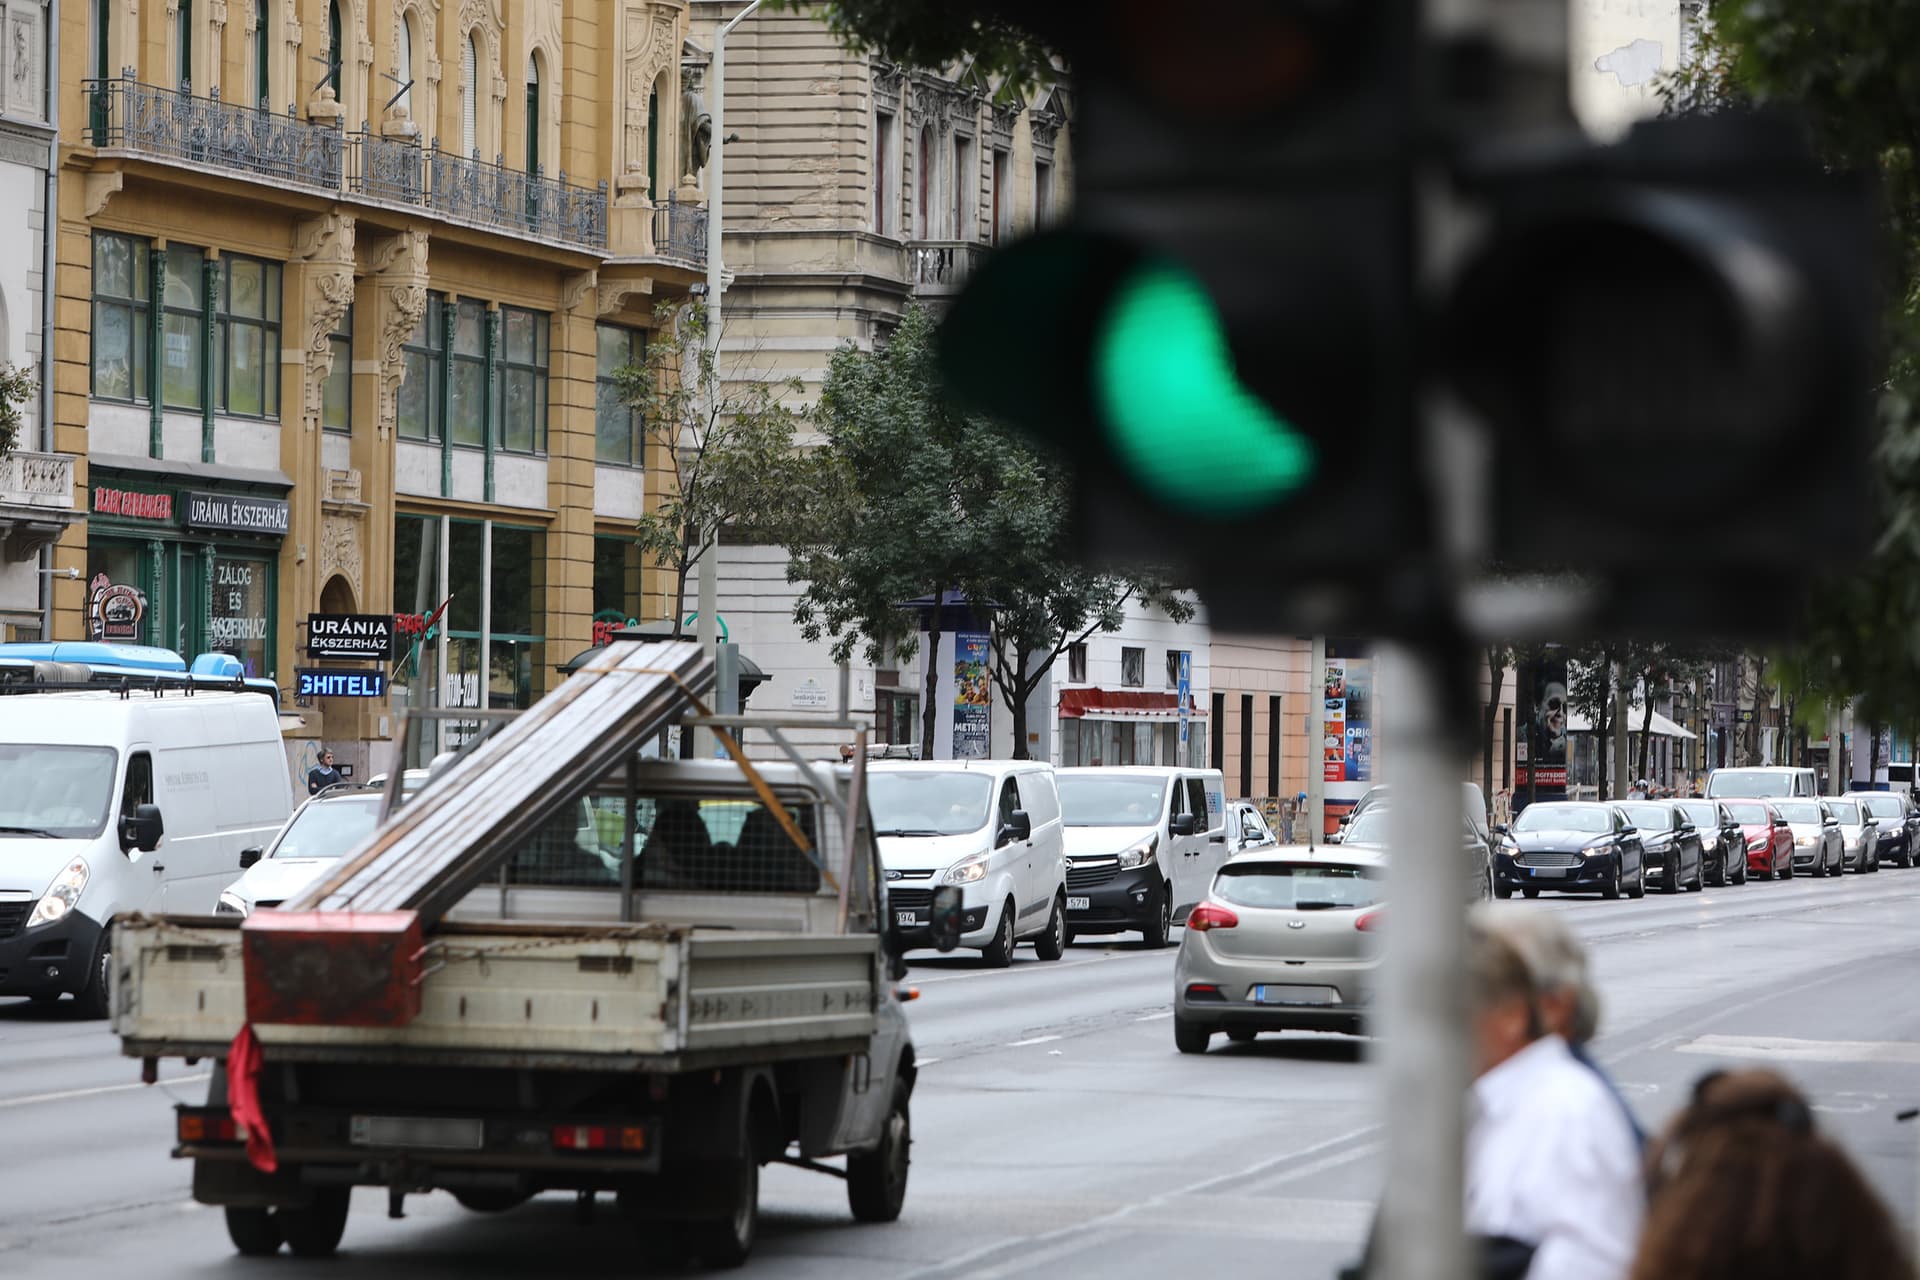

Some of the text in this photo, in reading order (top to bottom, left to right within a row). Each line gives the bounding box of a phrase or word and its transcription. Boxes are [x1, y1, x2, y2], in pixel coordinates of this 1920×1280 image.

[191, 497, 288, 529] URÁNIA ÉKSZERHÁZ
[218, 561, 252, 585] ZÁLOG
[229, 587, 242, 610] ÉS
[210, 612, 267, 639] KSZERHÁZ
[312, 617, 388, 636] URÁNIA
[311, 635, 388, 650] ÉKSZERHÁZ
